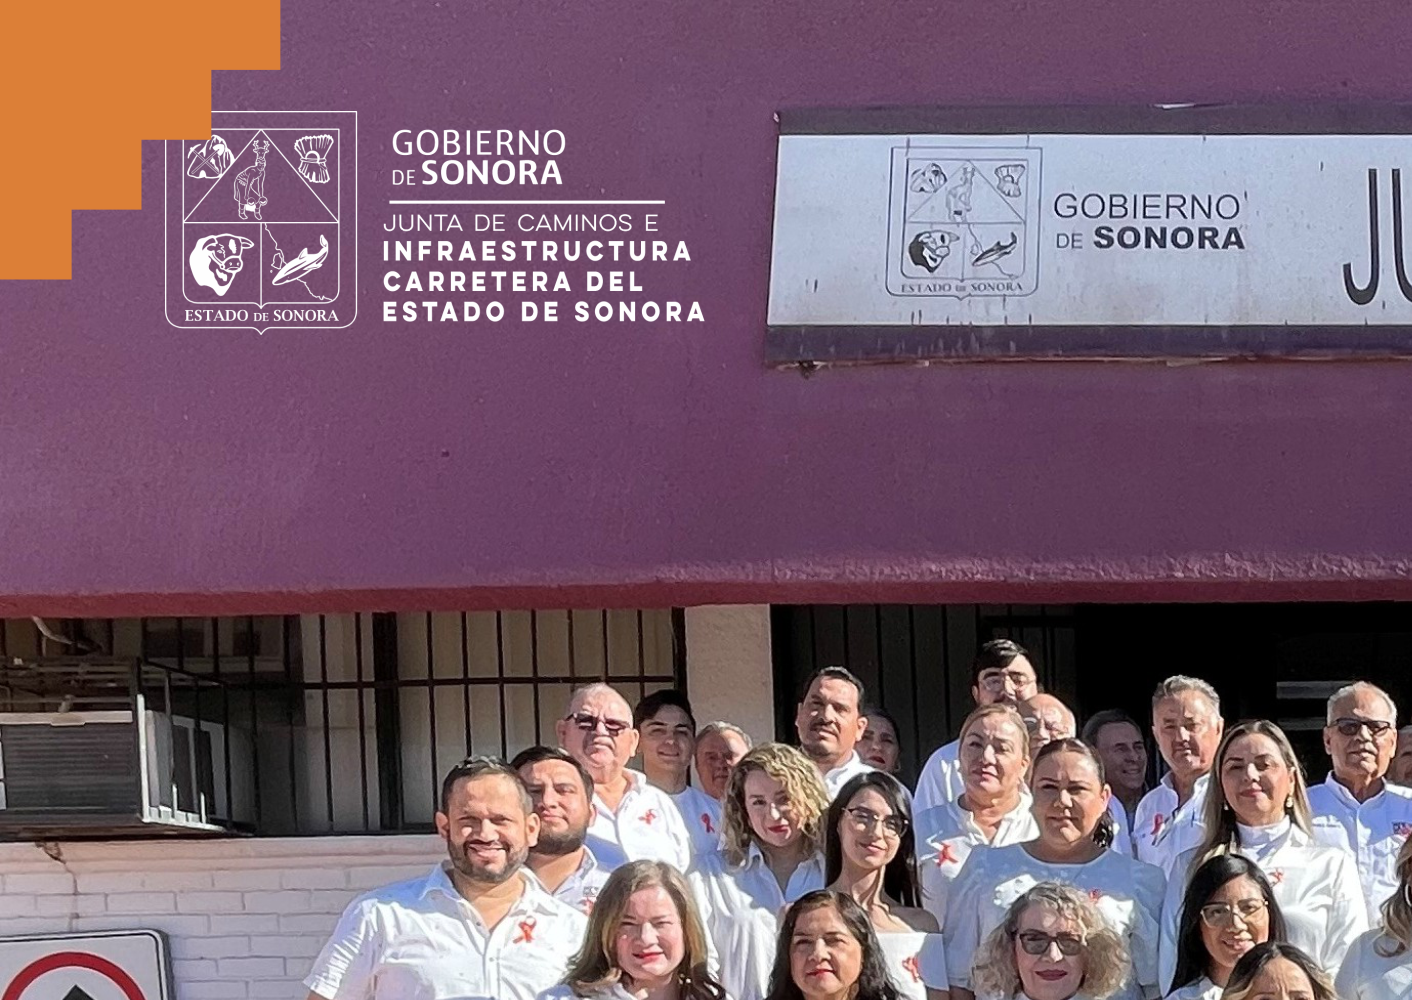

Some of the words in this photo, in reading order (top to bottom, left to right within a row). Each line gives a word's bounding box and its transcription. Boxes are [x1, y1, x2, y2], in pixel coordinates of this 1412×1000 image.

[1054, 193, 1240, 220] GOBIERNO
[1056, 233, 1083, 249] DE
[1093, 226, 1246, 250] SONORA
[901, 284, 952, 293] ESTADO
[971, 283, 1023, 292] SONORA
